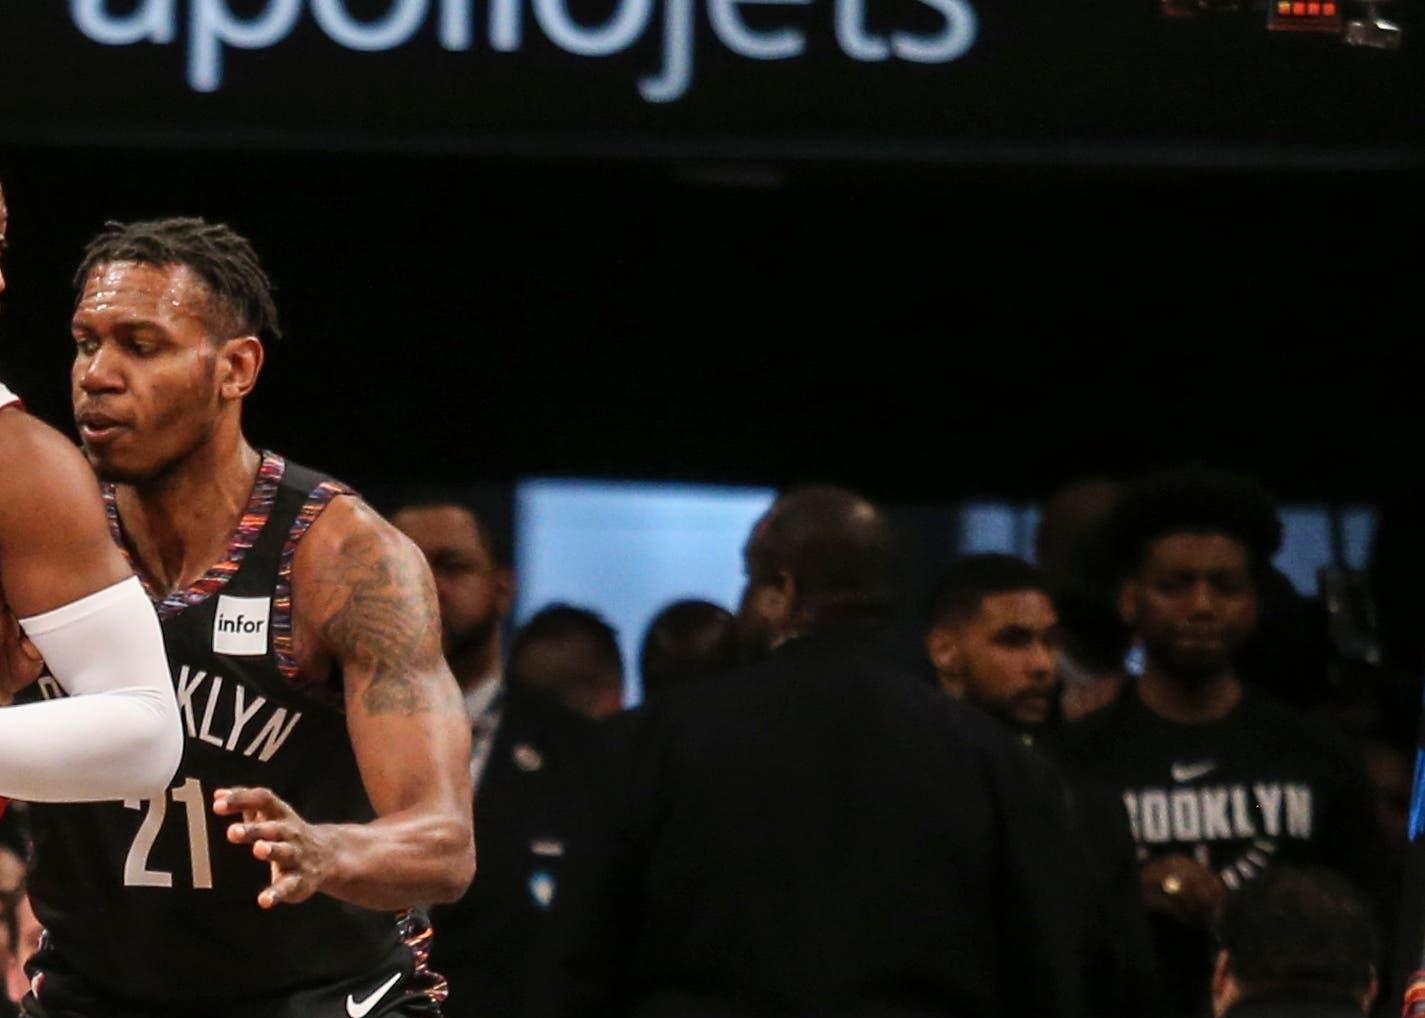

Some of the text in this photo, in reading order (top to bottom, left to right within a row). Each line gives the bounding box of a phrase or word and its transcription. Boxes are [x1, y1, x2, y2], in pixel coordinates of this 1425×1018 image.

[218, 612, 265, 634] infor
[123, 777, 213, 889] 21
[1123, 780, 1312, 843] OOKLYN
